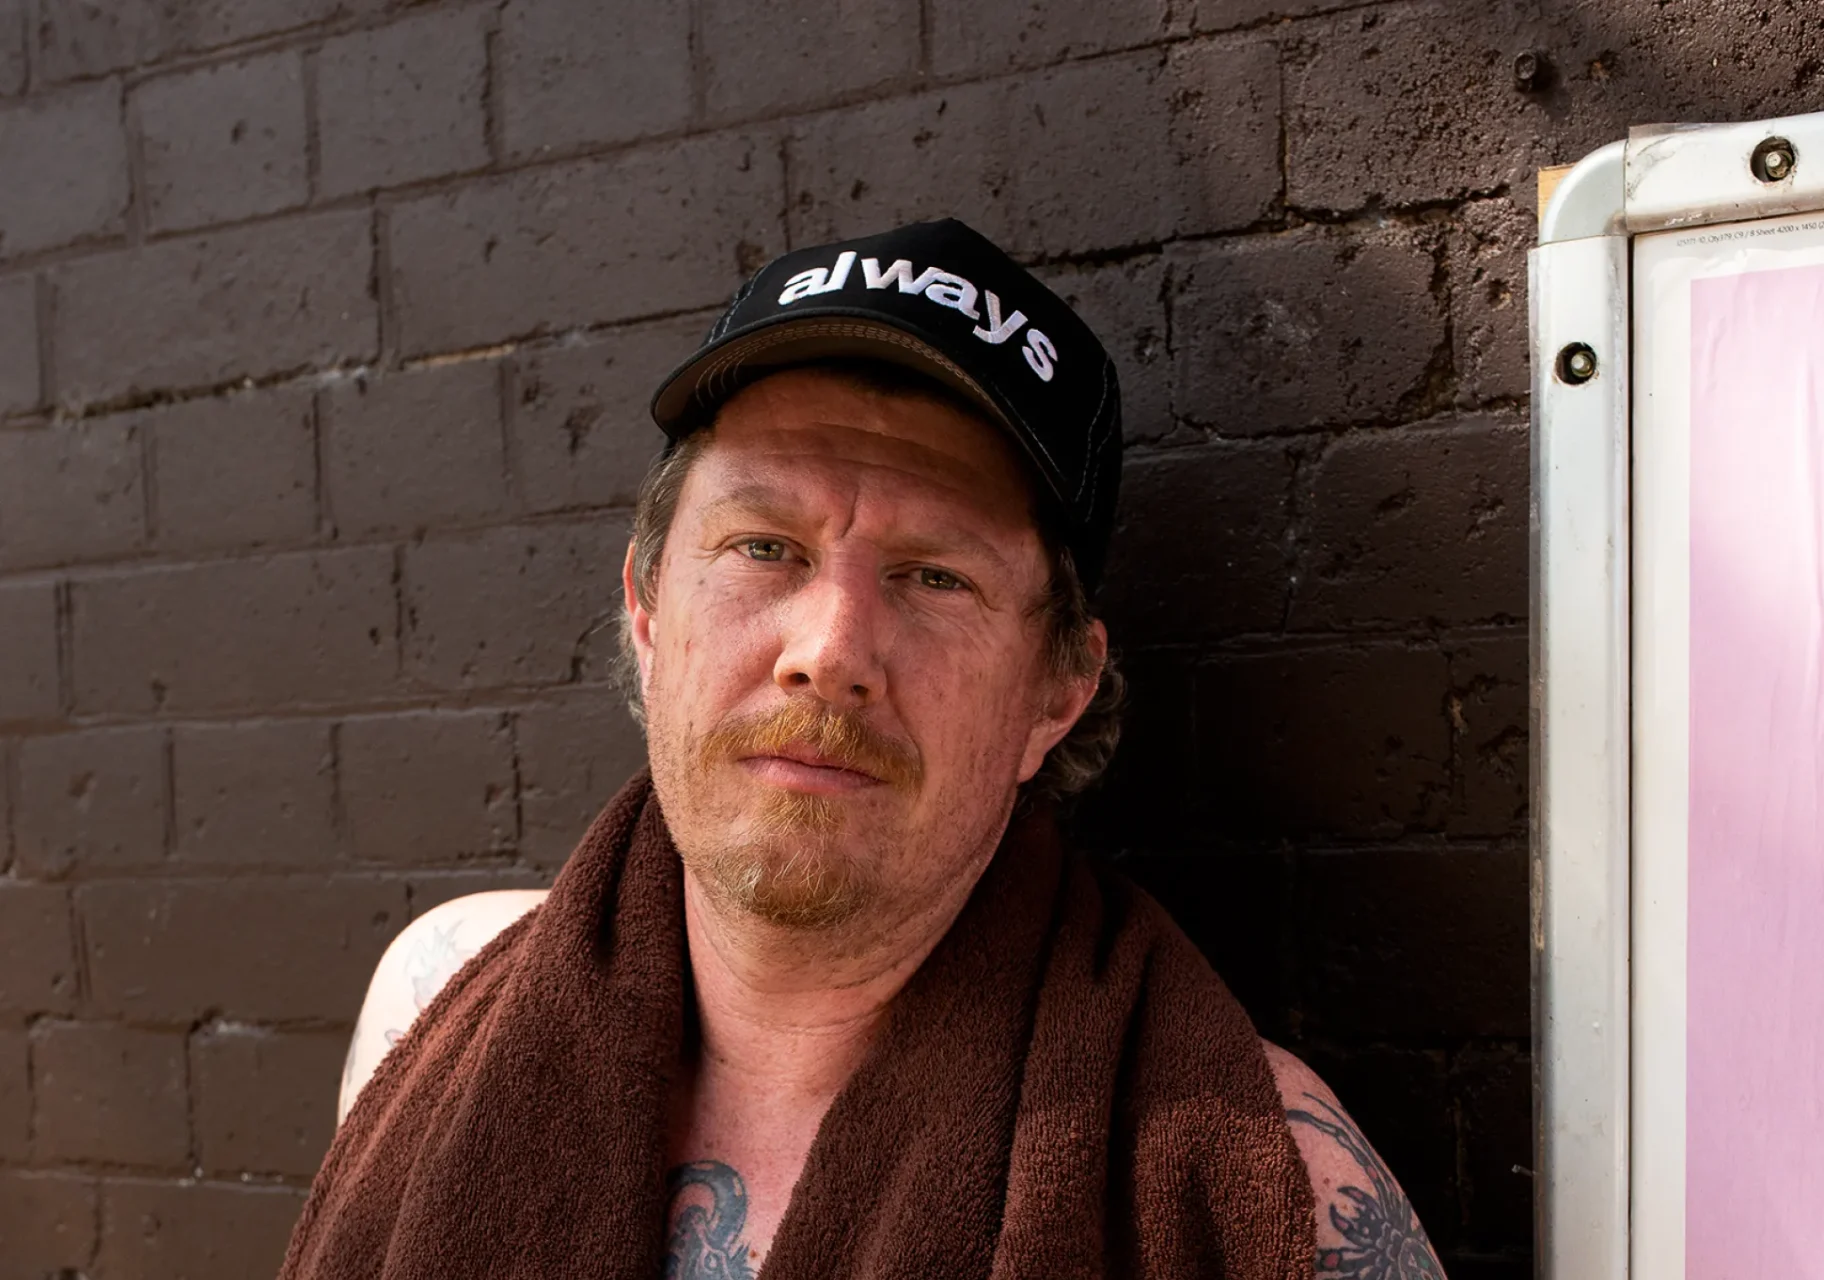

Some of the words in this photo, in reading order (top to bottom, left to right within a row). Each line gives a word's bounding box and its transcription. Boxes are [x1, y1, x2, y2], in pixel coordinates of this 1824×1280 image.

[1756, 228, 1775, 236] Sheet
[1776, 225, 1794, 233] 4200
[1801, 222, 1817, 230] 1450
[778, 251, 1058, 382] always
